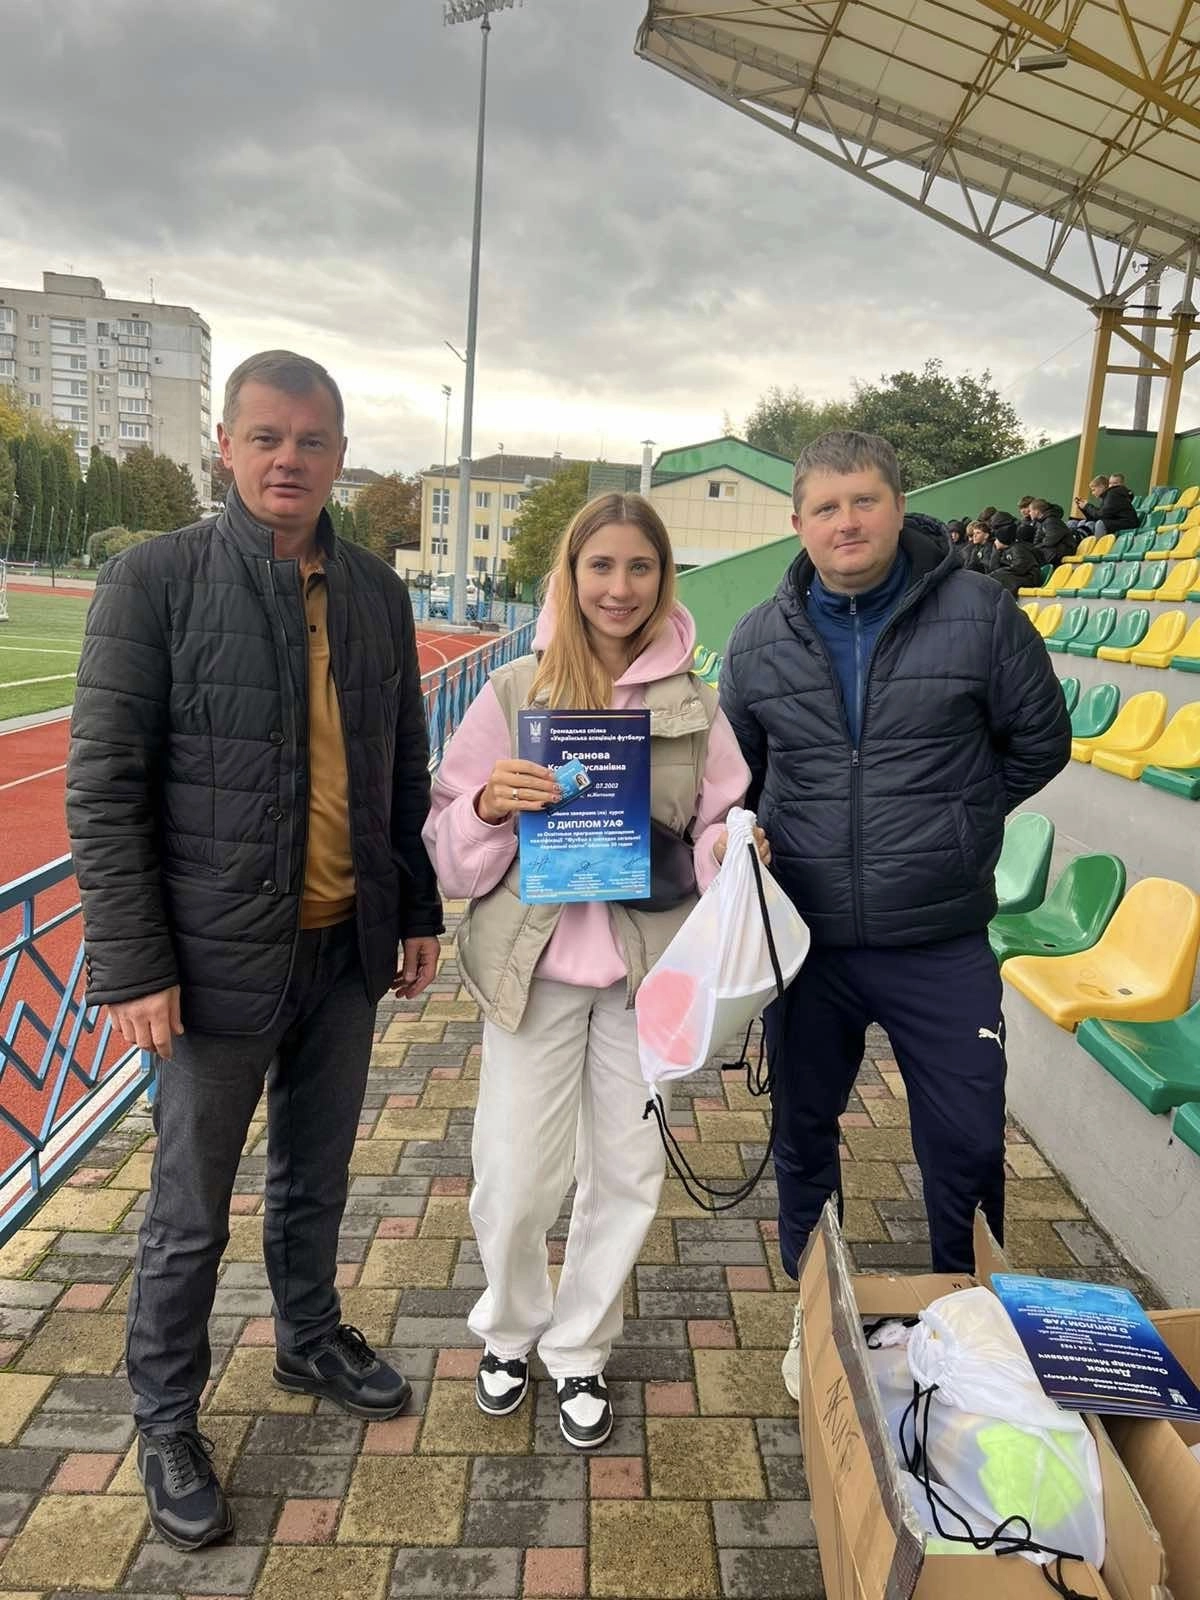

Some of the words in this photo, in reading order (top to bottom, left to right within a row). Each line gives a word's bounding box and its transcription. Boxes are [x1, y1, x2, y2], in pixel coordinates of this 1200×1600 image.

[562, 751, 610, 760] Гасанова
[547, 821, 555, 830] D
[556, 820, 601, 830] ДИПЛОМ
[602, 819, 624, 828] УАФ
